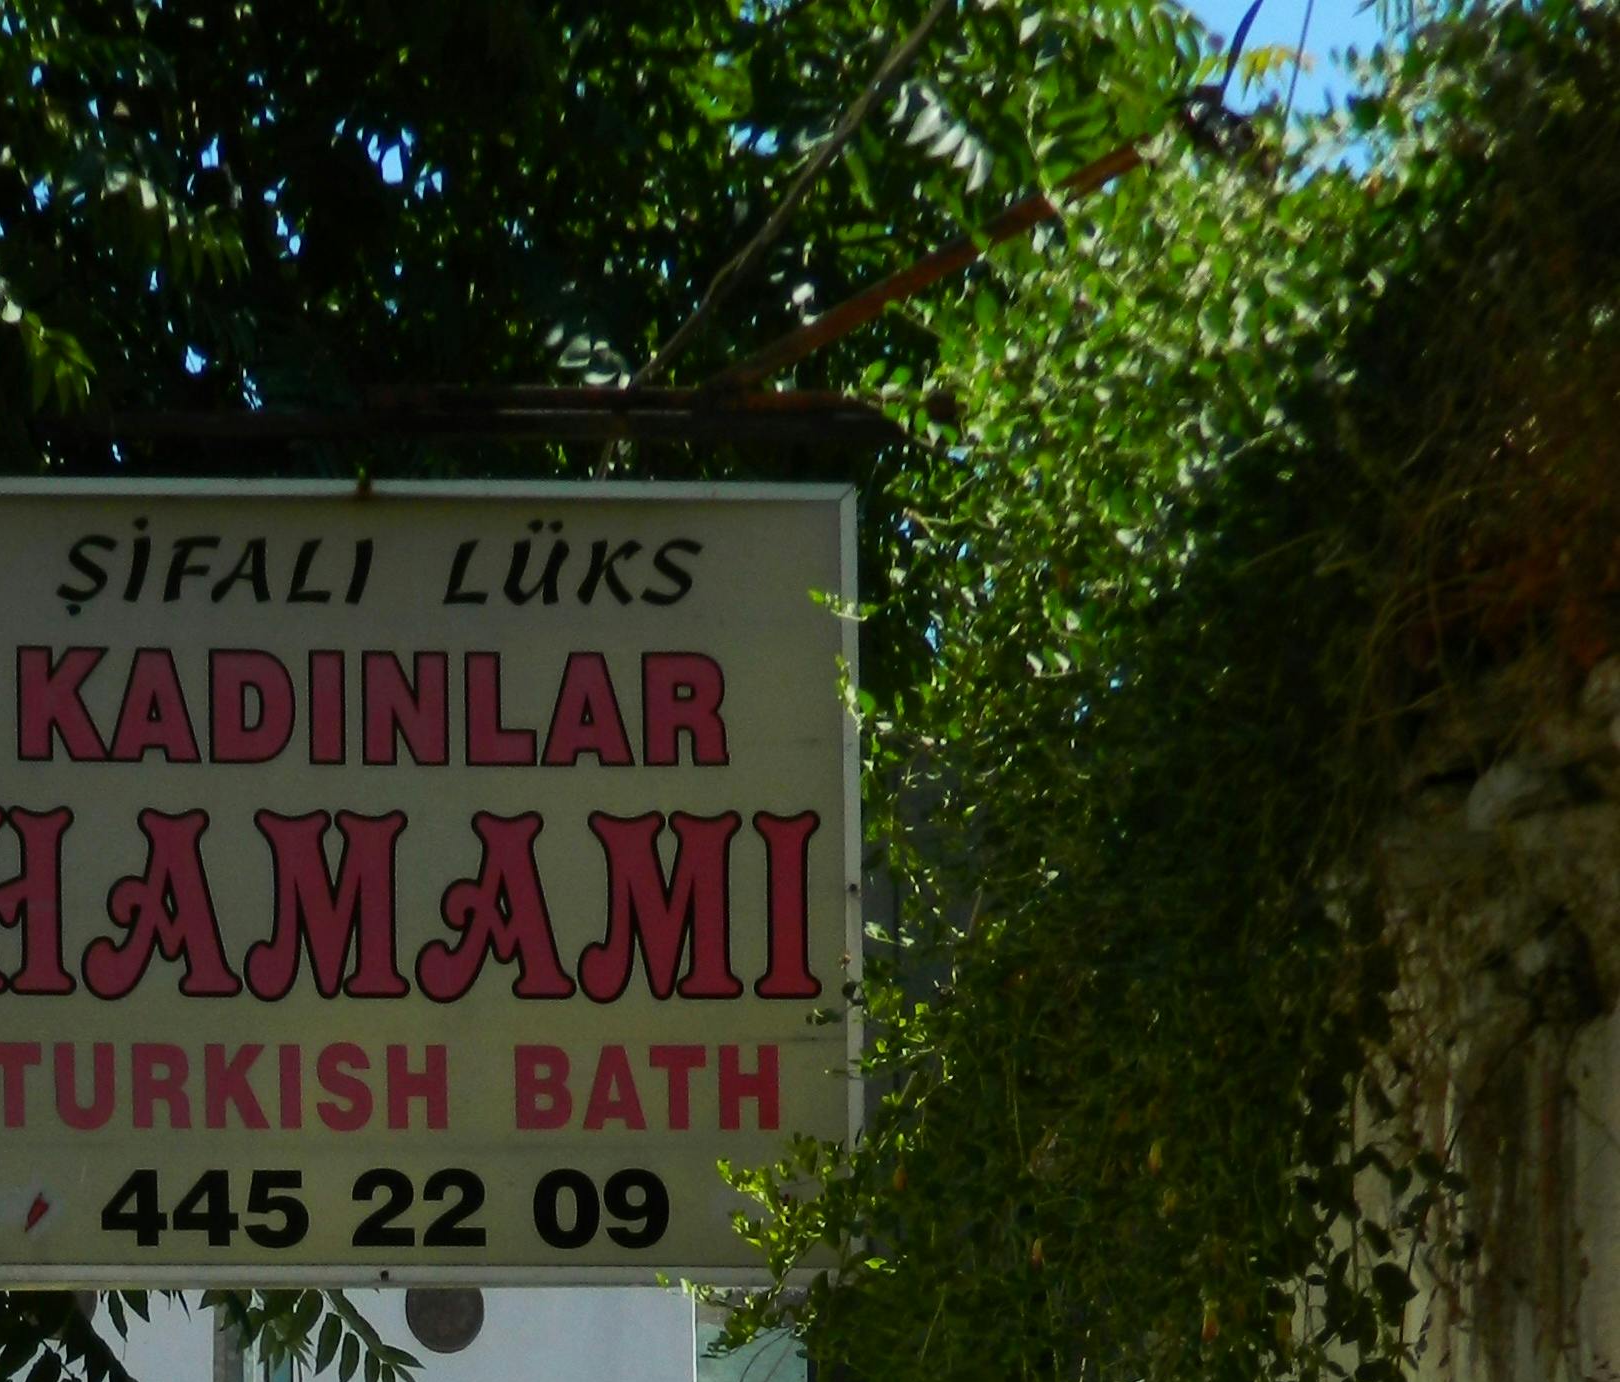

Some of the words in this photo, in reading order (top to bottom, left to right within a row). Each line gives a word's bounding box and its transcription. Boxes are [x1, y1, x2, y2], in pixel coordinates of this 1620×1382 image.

[56, 515, 374, 617] ŞİFALI
[443, 519, 703, 606] LÜKS
[15, 644, 730, 768] KADINLAR
[514, 1043, 780, 1132] BATH
[100, 1168, 310, 1250] 445
[351, 1167, 487, 1249] 22
[532, 1167, 670, 1250] 09
